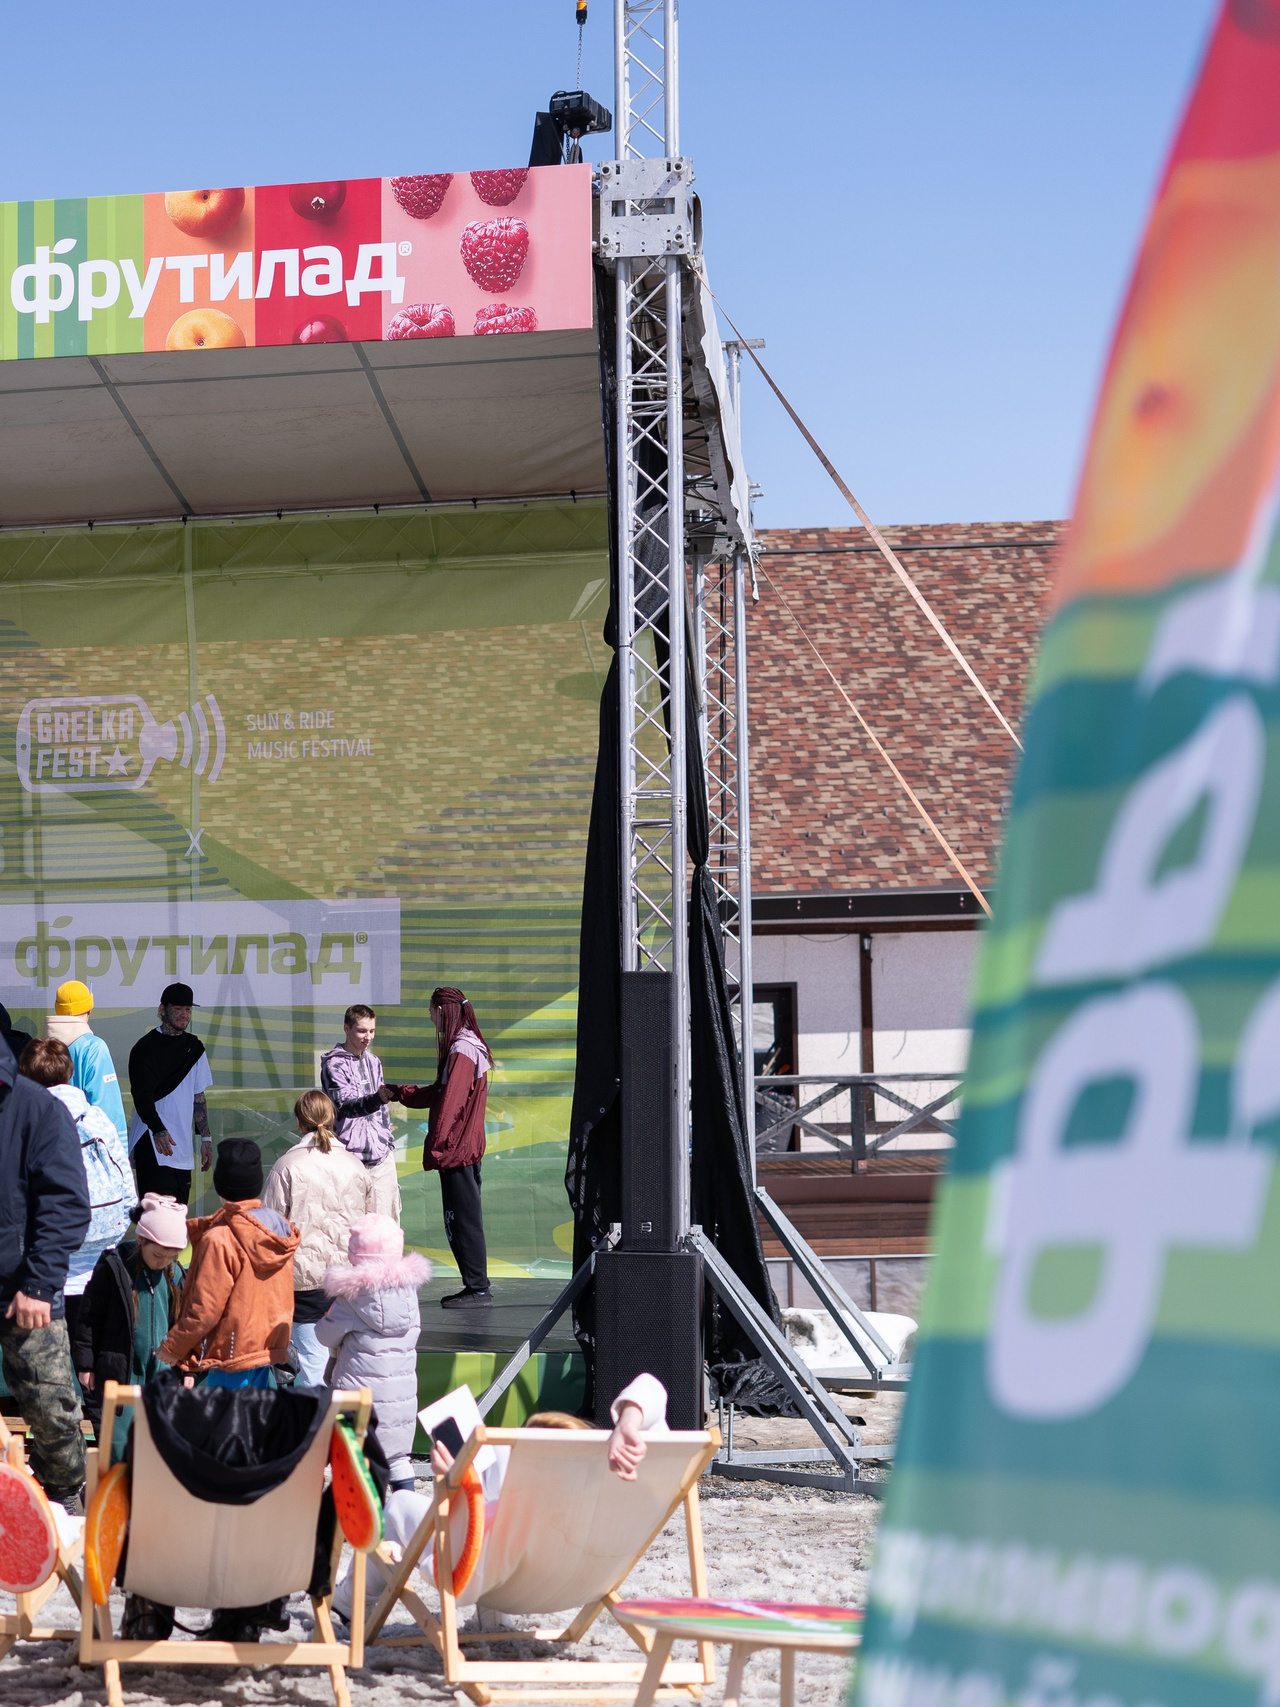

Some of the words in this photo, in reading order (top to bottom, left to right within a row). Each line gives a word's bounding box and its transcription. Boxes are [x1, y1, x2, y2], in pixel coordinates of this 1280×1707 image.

[36, 708, 134, 744] GRELKA
[246, 712, 279, 732] SUN
[283, 712, 296, 730] &
[299, 710, 336, 729] RIDE
[36, 746, 102, 779] FEST
[247, 740, 299, 760] MUSIC
[302, 738, 375, 758] FESTIVAL
